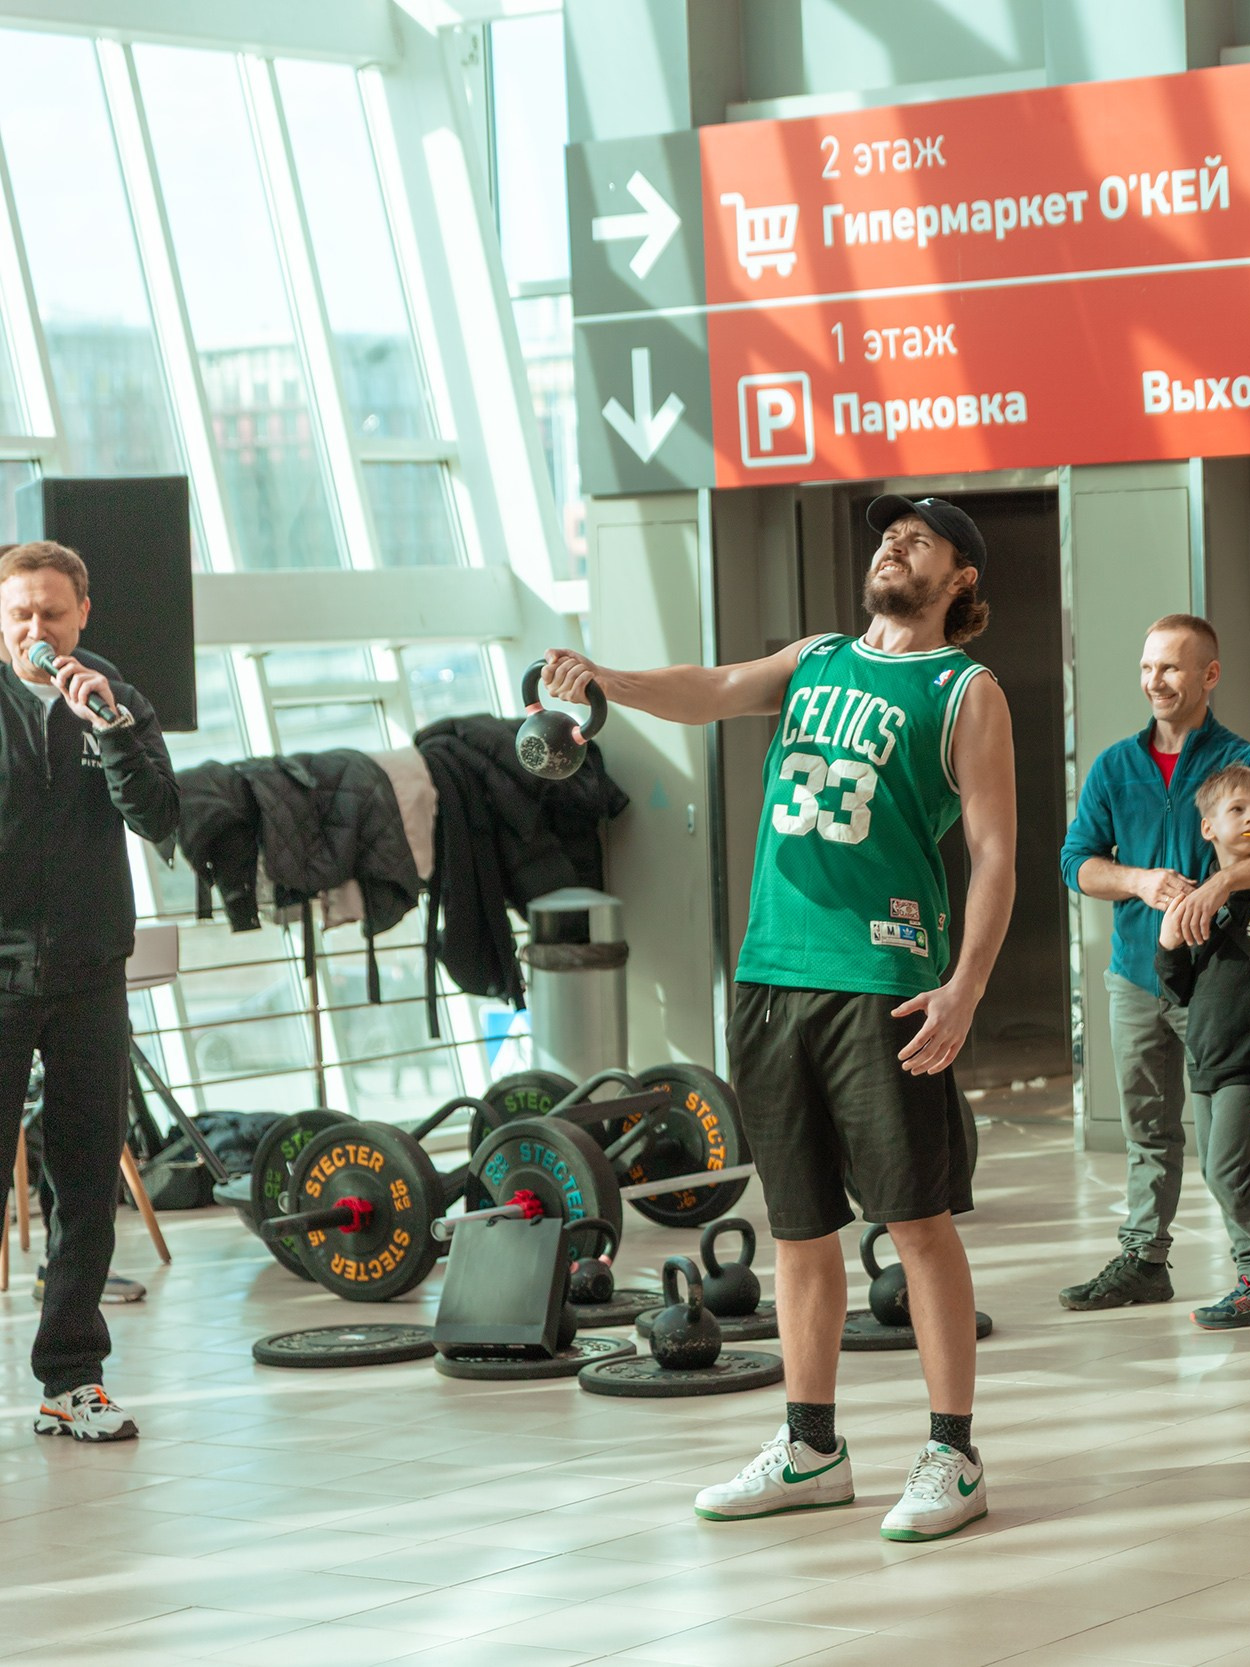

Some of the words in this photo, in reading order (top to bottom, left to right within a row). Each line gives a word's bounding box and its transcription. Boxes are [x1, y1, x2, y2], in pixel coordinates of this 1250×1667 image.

[820, 134, 843, 179] 2
[852, 135, 946, 177] этаж
[822, 189, 1089, 250] Гипермаркет
[831, 322, 846, 362] 1
[863, 323, 958, 361] этаж
[832, 389, 1028, 441] Парковка
[781, 685, 906, 766] CELTICS
[771, 752, 879, 845] 33
[886, 926, 896, 936] M
[684, 1091, 727, 1182] STECTE
[305, 1144, 385, 1199] STECTER
[330, 1228, 412, 1282] STECTER
